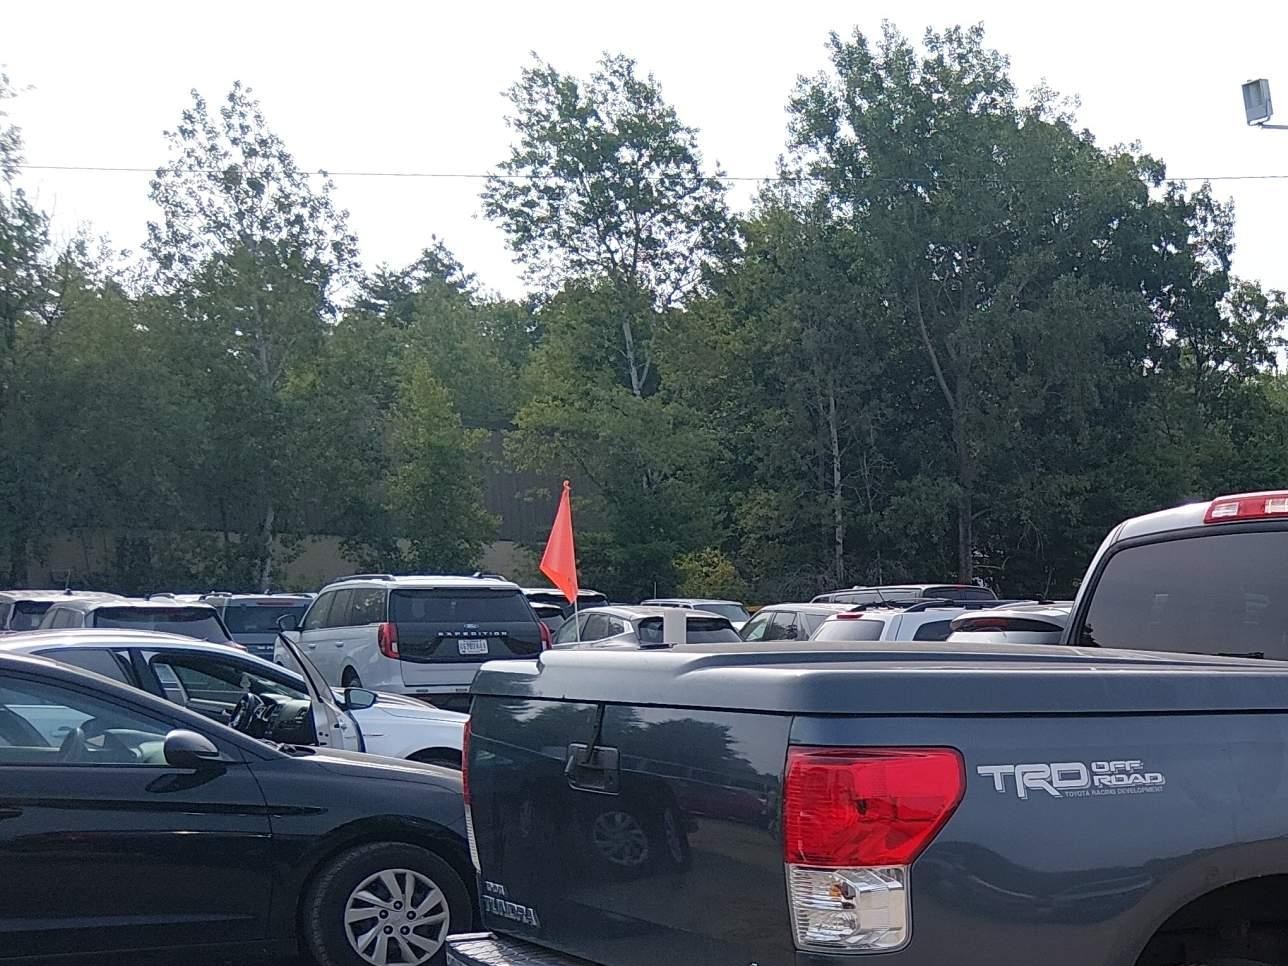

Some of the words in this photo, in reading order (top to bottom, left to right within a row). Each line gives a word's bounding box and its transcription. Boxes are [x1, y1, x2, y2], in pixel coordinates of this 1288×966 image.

[1091, 760, 1144, 774] OFF
[976, 762, 1091, 799] TRD
[1093, 772, 1166, 788] ROAD
